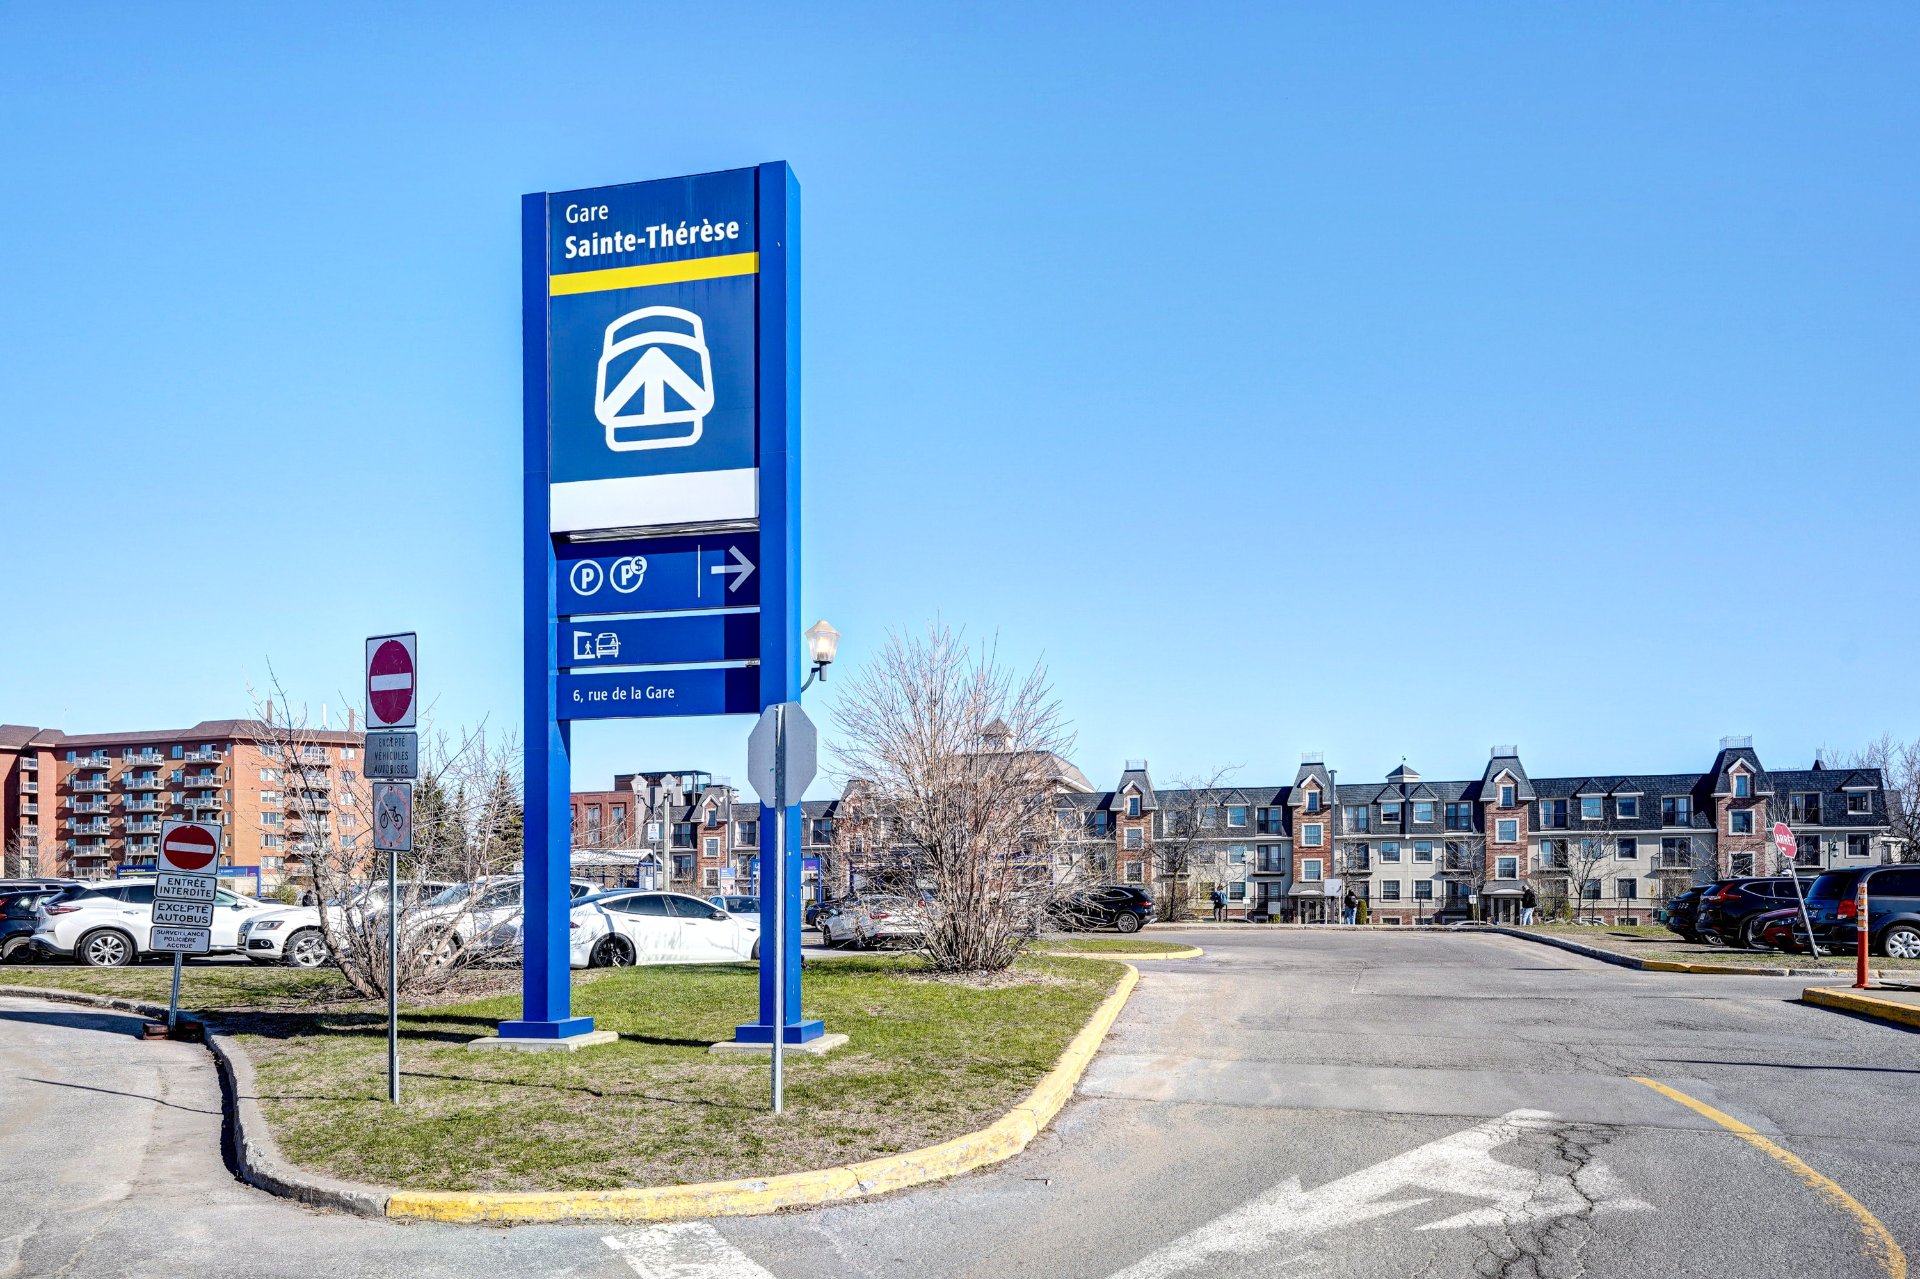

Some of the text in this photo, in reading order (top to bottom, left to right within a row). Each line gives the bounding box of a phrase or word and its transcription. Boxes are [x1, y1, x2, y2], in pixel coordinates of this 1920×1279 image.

[565, 203, 609, 223] Gare
[565, 219, 739, 258] Sainte-Thérèse
[573, 686, 675, 703] 6, rue de la Gare
[374, 749, 409, 760] VÉHICULES
[167, 877, 206, 888] ENTRÉE
[159, 886, 212, 898] INTERDITE
[158, 903, 209, 914] EXCEPTÉ
[156, 914, 209, 924] AUTOBUS
